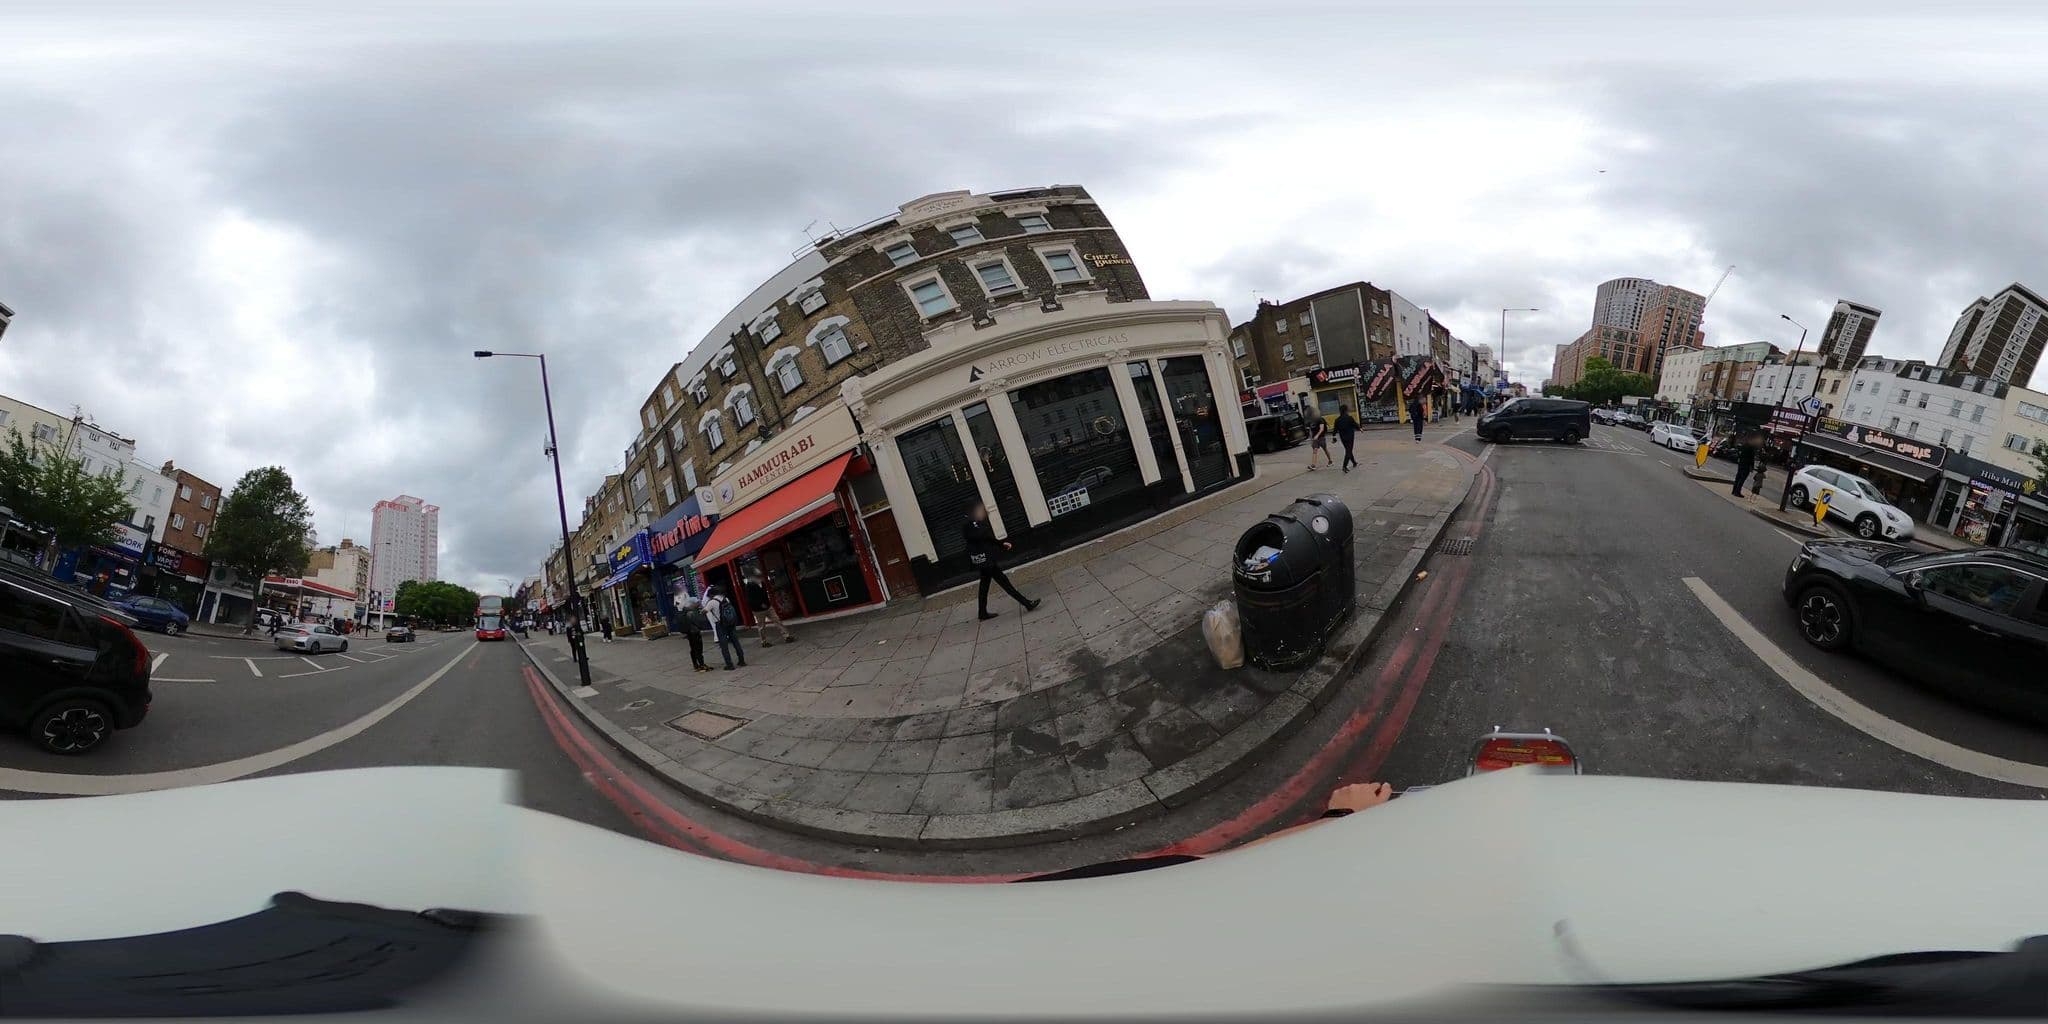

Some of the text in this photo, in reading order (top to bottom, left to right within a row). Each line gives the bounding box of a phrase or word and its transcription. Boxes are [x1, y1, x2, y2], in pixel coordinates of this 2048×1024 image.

[989, 332, 1128, 374] ARROW ELECTRICALS
[1865, 430, 1932, 459] عروس دمشق
[738, 434, 816, 489] HAMMURABI
[759, 461, 794, 486] CENTRE
[1981, 470, 2021, 489] Hiba Mall
